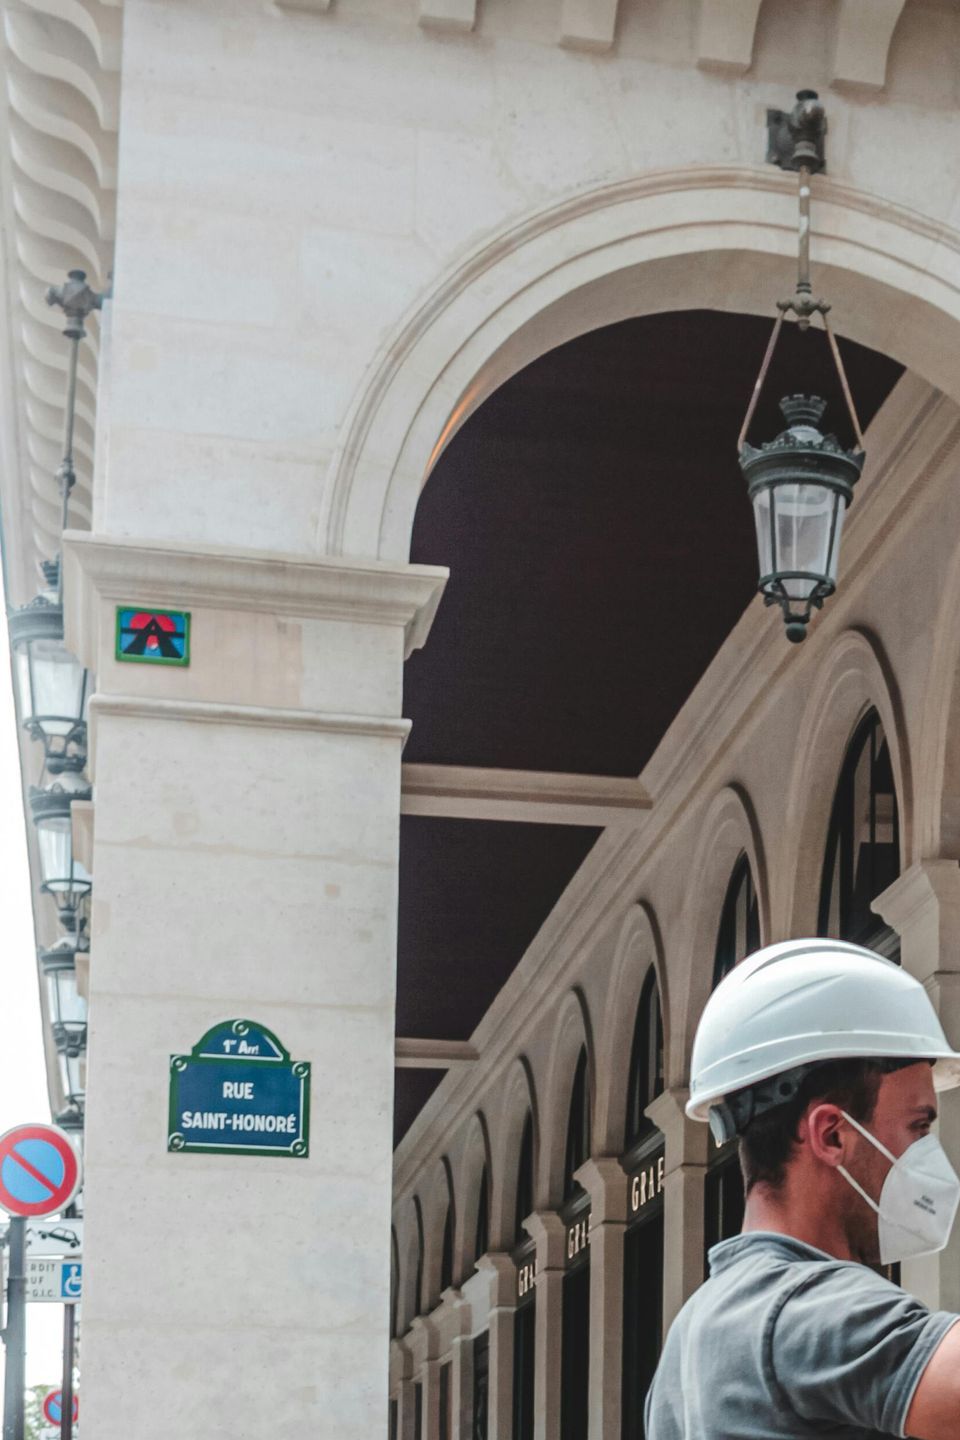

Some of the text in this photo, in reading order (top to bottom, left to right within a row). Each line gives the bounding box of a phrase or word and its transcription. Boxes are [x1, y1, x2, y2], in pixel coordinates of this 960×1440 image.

[222, 1081, 254, 1099] RUE
[181, 1111, 297, 1133] SAINT-HONORÉ
[518, 1259, 537, 1297] GRA
